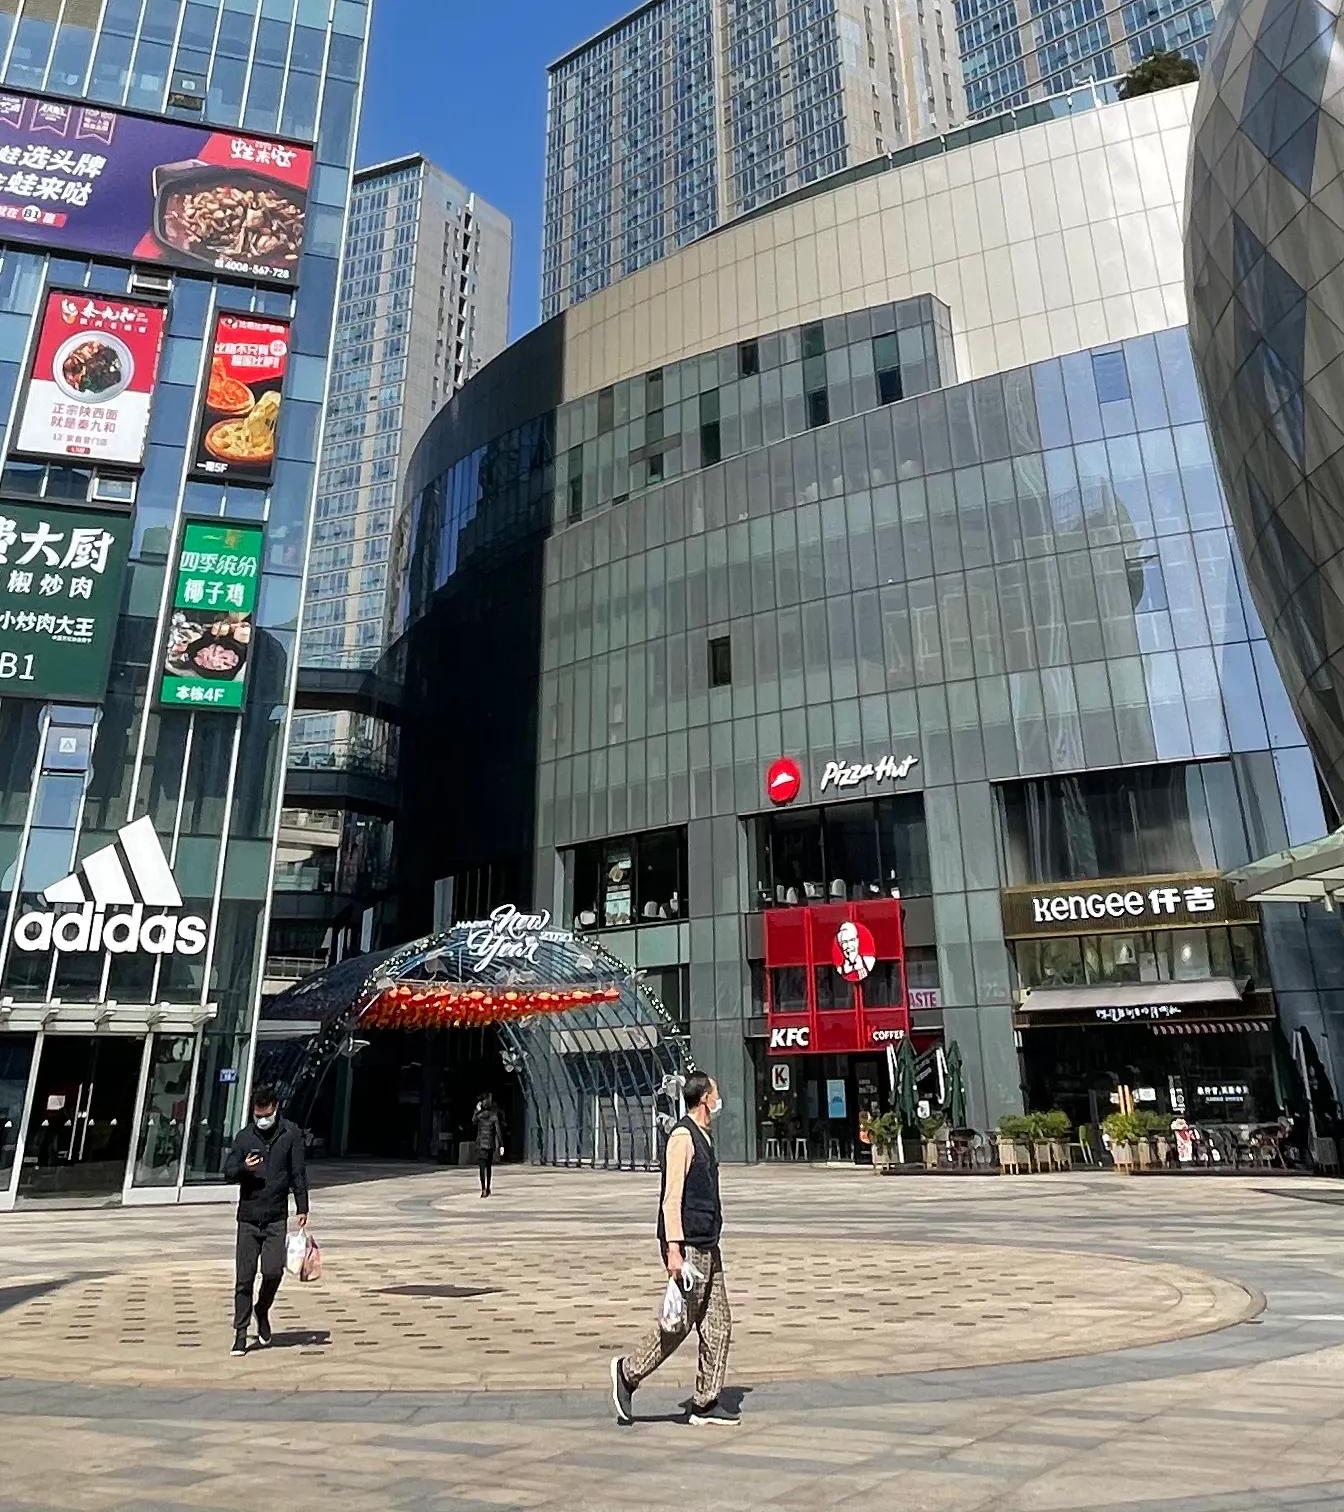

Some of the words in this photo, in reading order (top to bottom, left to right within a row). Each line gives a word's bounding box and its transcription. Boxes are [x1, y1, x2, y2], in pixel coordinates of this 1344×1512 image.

[51, 416, 116, 432] 就是秦九和
[52, 402, 118, 420] 正宗陕西面
[179, 551, 257, 578] 四季缤纷
[184, 578, 245, 607] 椰子鸡
[820, 760, 875, 791] Pizza
[874, 754, 920, 782] Hut
[1148, 886, 1216, 914] 仟吉
[13, 901, 207, 955] adidas
[769, 1026, 810, 1048] KFC
